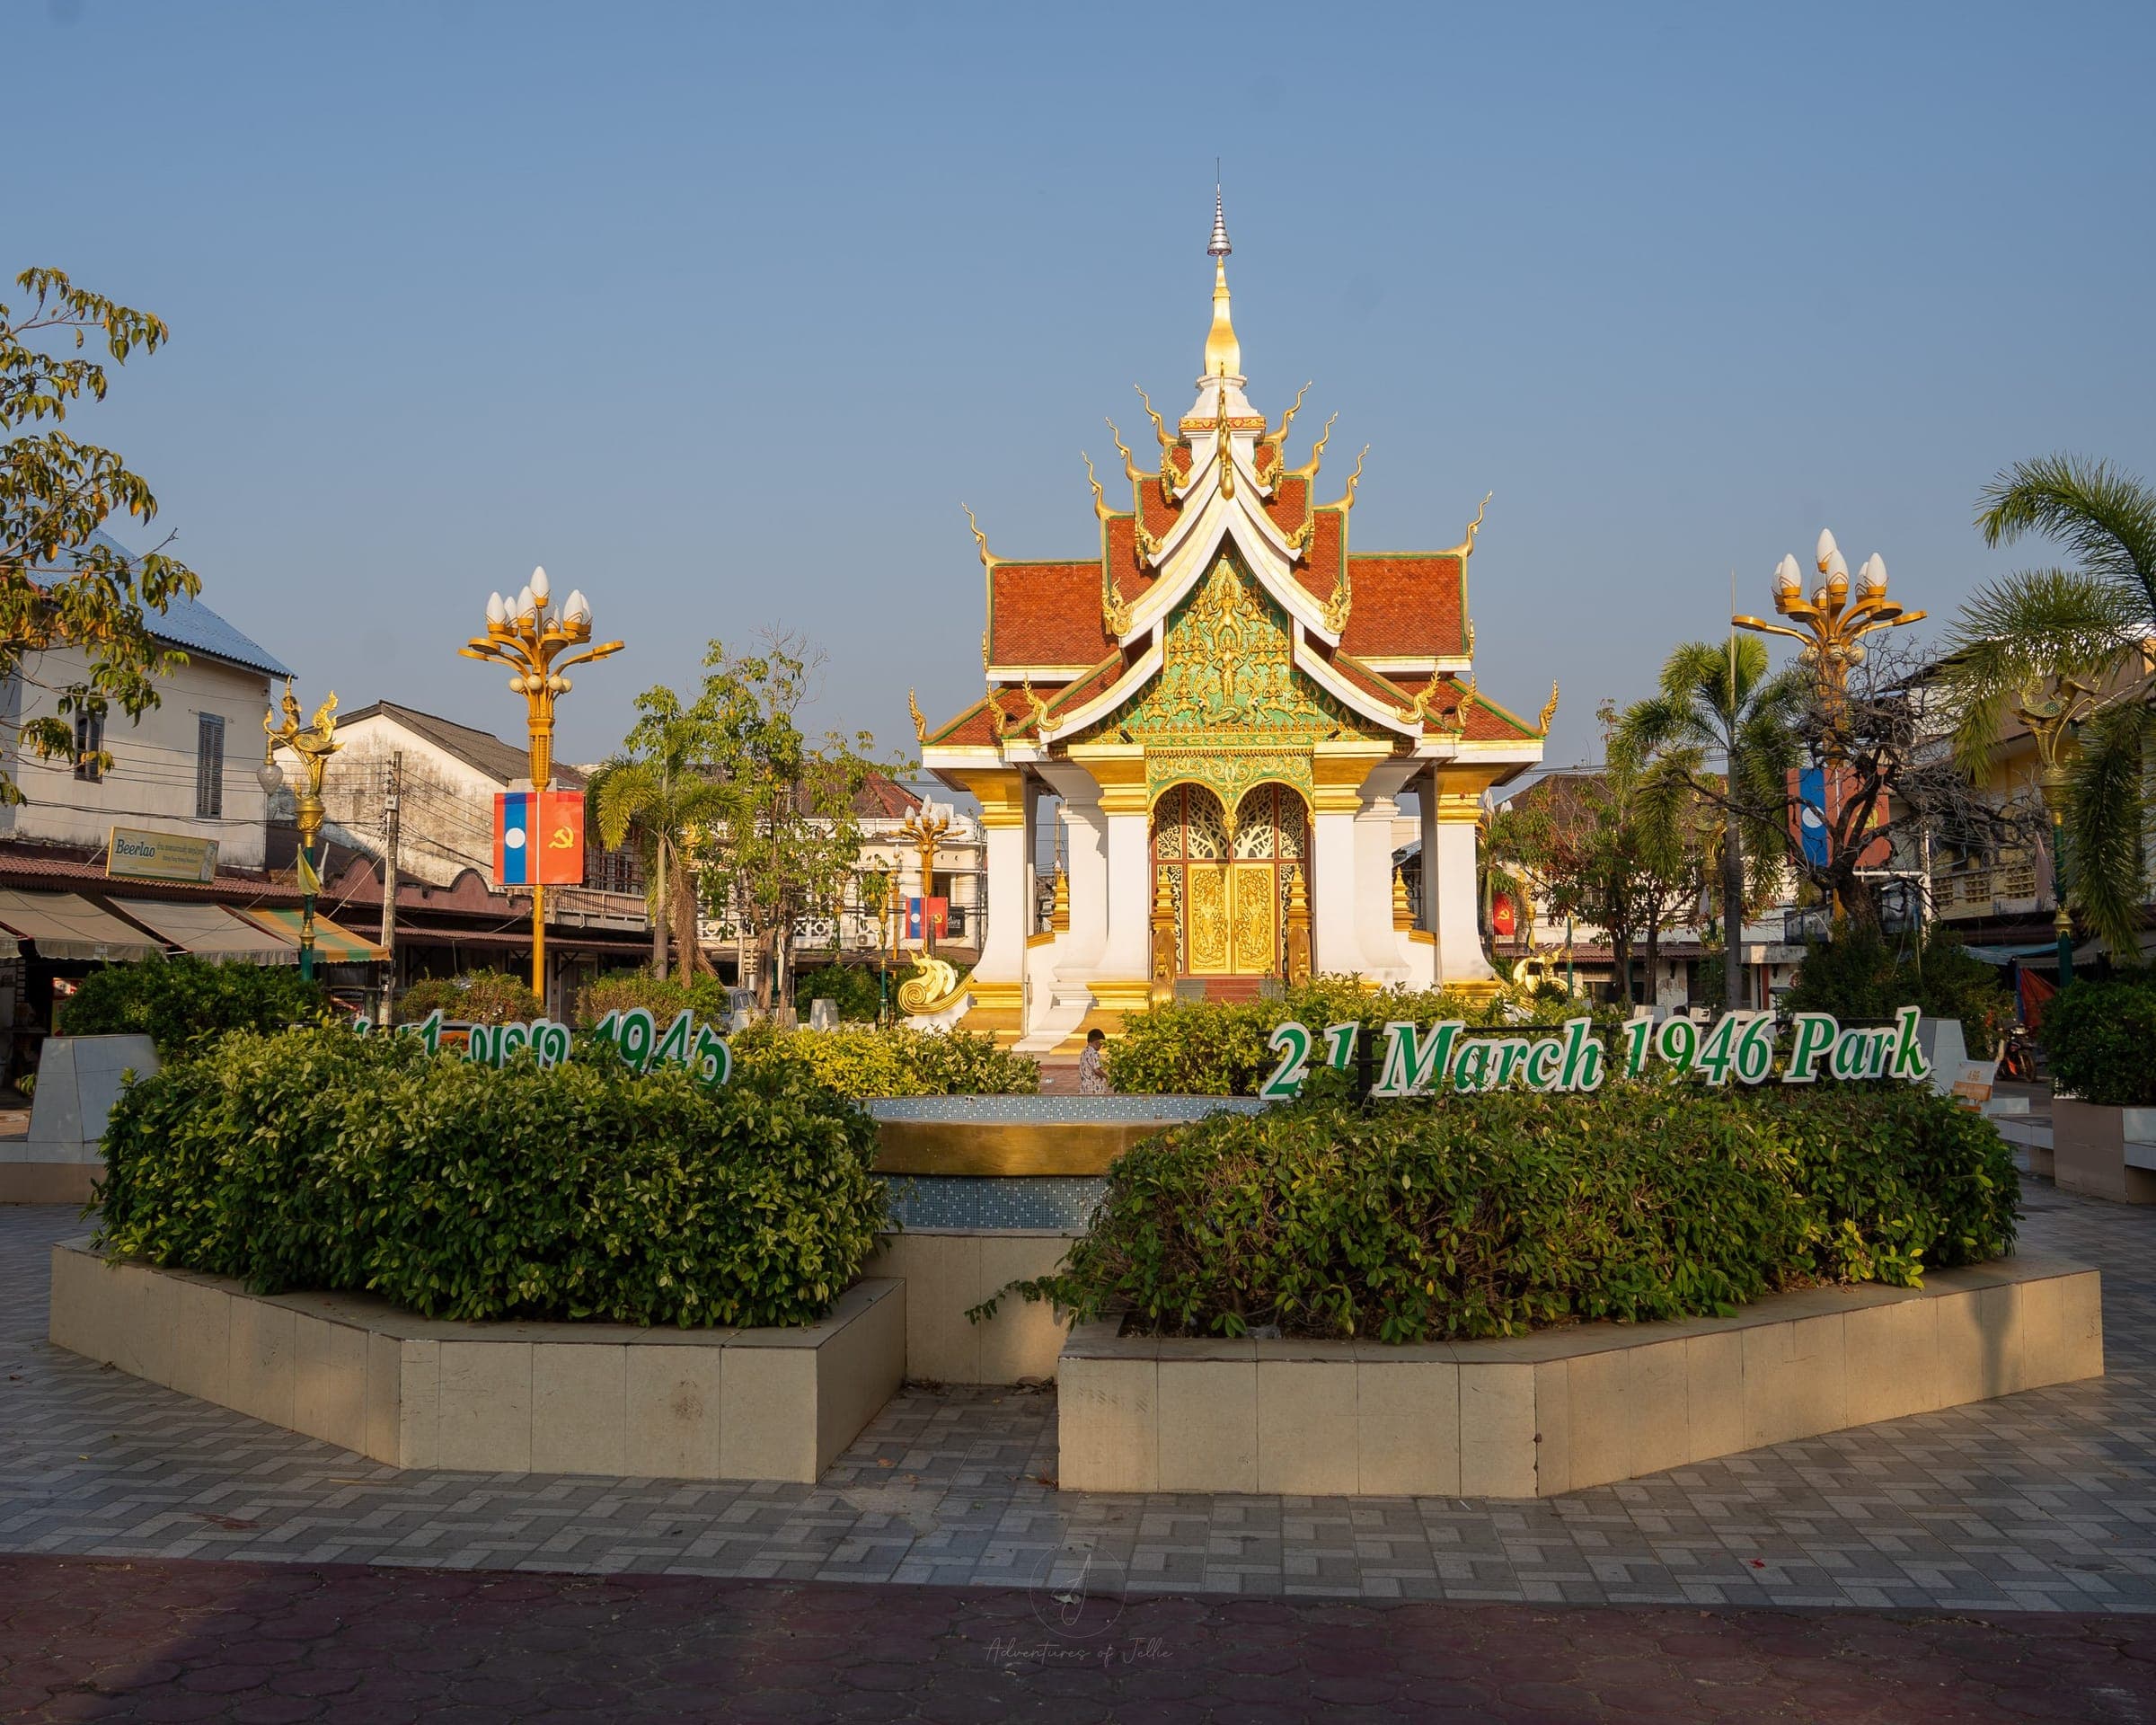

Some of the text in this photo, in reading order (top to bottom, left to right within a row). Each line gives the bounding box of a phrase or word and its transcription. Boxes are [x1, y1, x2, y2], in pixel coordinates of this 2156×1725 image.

[115, 838, 155, 858] Beerlao
[1259, 1004, 1932, 1101] 21 March 1946 Park
